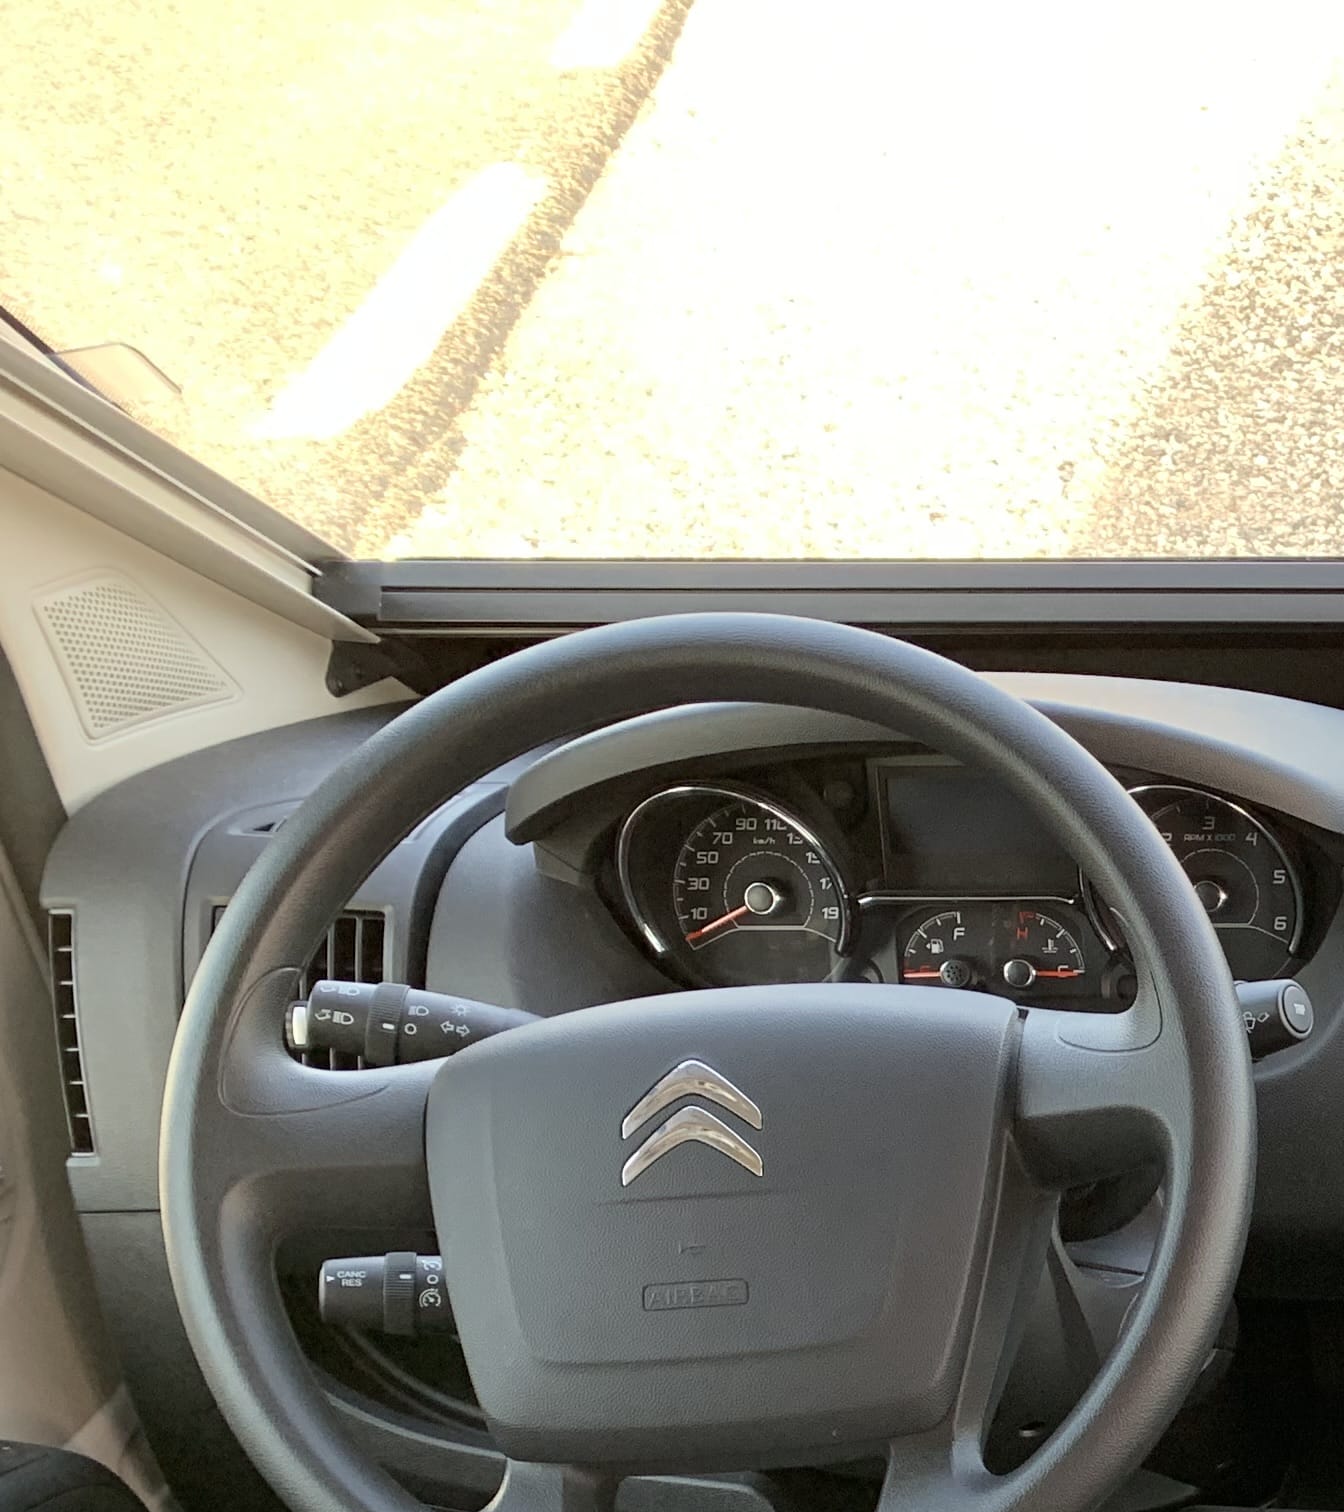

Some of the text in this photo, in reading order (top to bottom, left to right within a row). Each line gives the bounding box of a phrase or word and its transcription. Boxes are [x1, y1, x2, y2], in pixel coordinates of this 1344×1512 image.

[735, 818, 757, 831] 90
[712, 832, 733, 845] 70
[1245, 832, 1258, 846] 4
[696, 851, 719, 864] 50
[1272, 869, 1286, 884] 5
[687, 878, 710, 890] 30
[690, 908, 708, 920] 10
[1274, 916, 1288, 931] 6
[953, 927, 966, 941] F
[1016, 927, 1029, 940] H
[336, 1270, 367, 1279] CANC
[341, 1278, 362, 1287] RES
